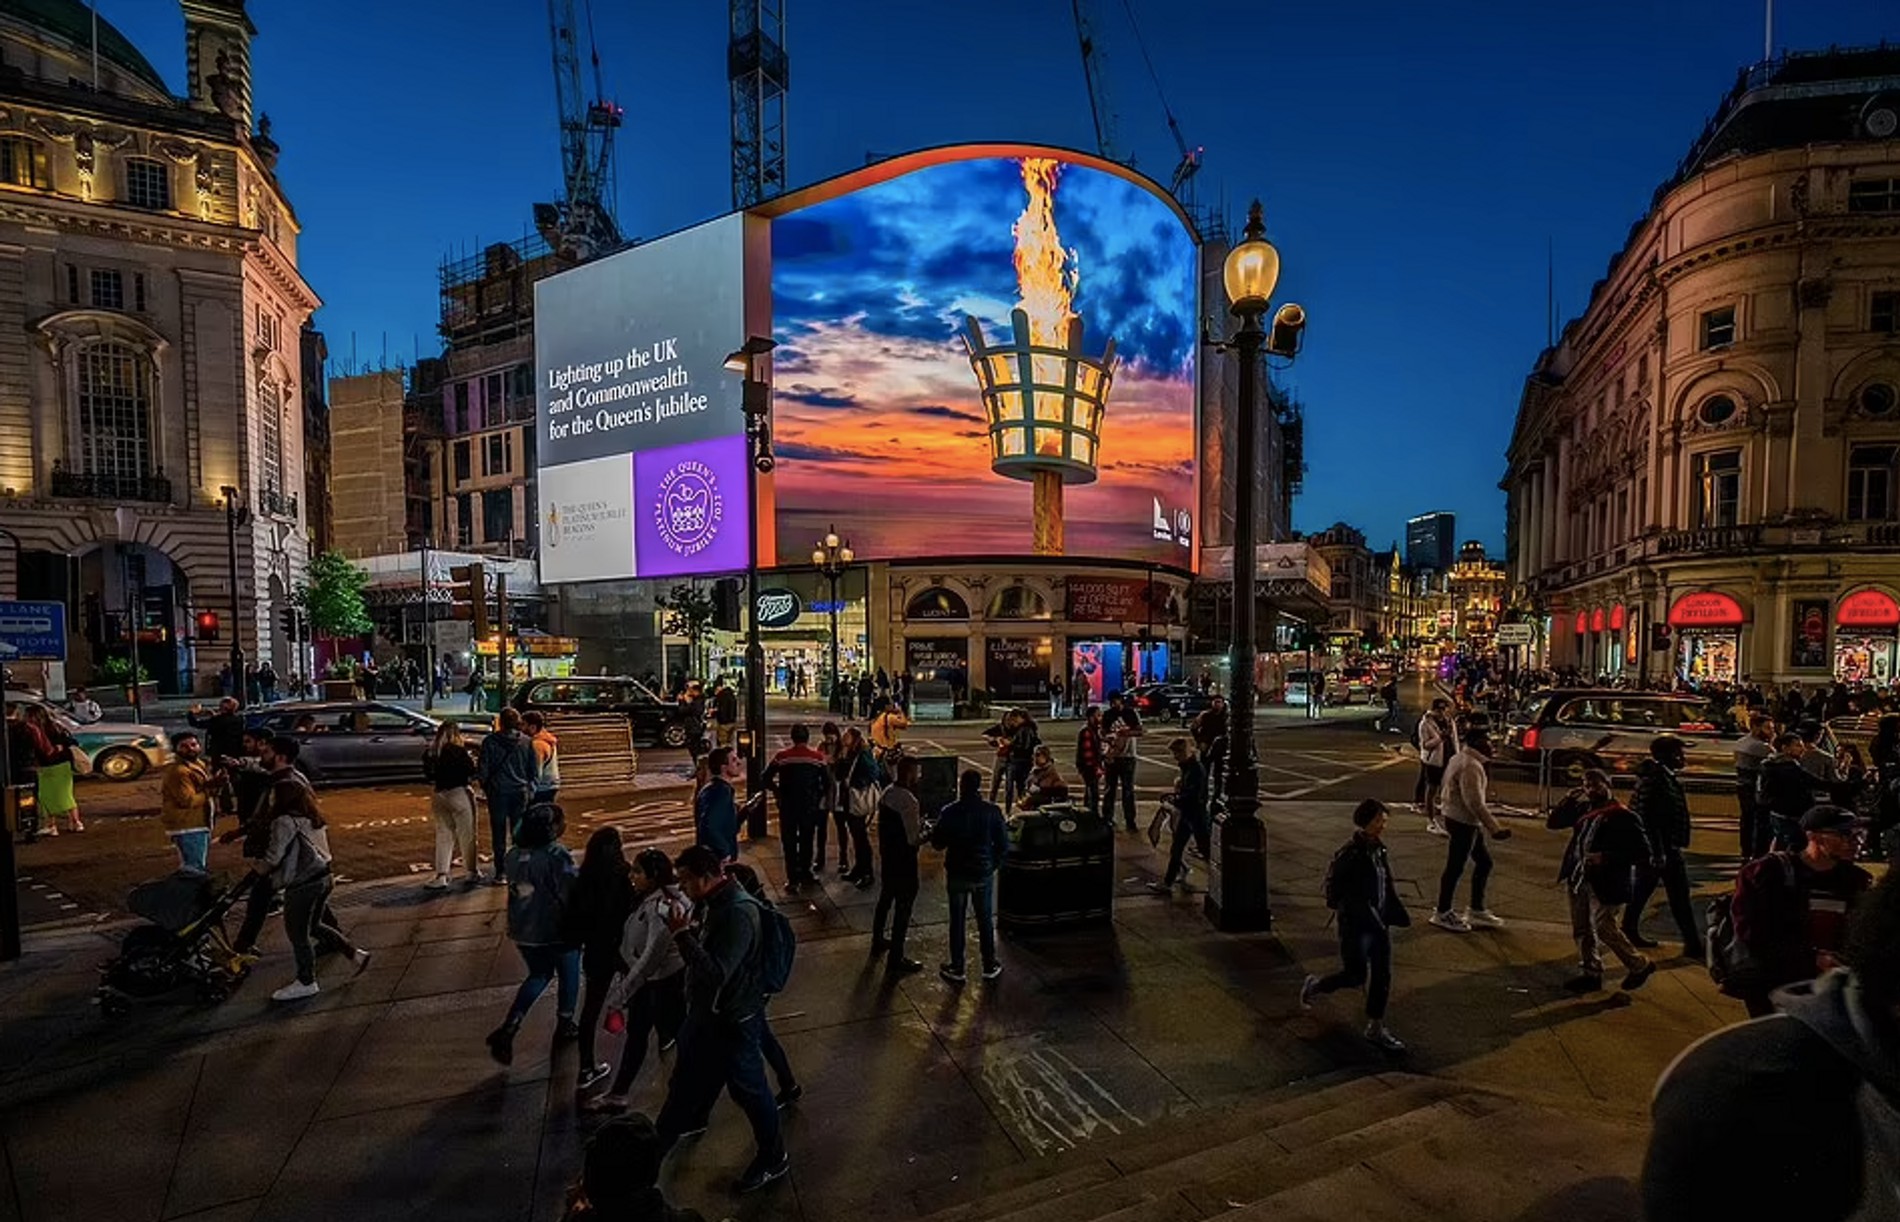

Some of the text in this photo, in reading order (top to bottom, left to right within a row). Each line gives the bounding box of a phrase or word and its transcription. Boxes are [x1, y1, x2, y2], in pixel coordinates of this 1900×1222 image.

[549, 338, 677, 391] Lighting up the UK
[549, 365, 688, 414] and Commonwealth
[549, 392, 708, 440] for the Queen's Jubilee
[661, 469, 677, 489] THE
[10, 604, 52, 615] LANE
